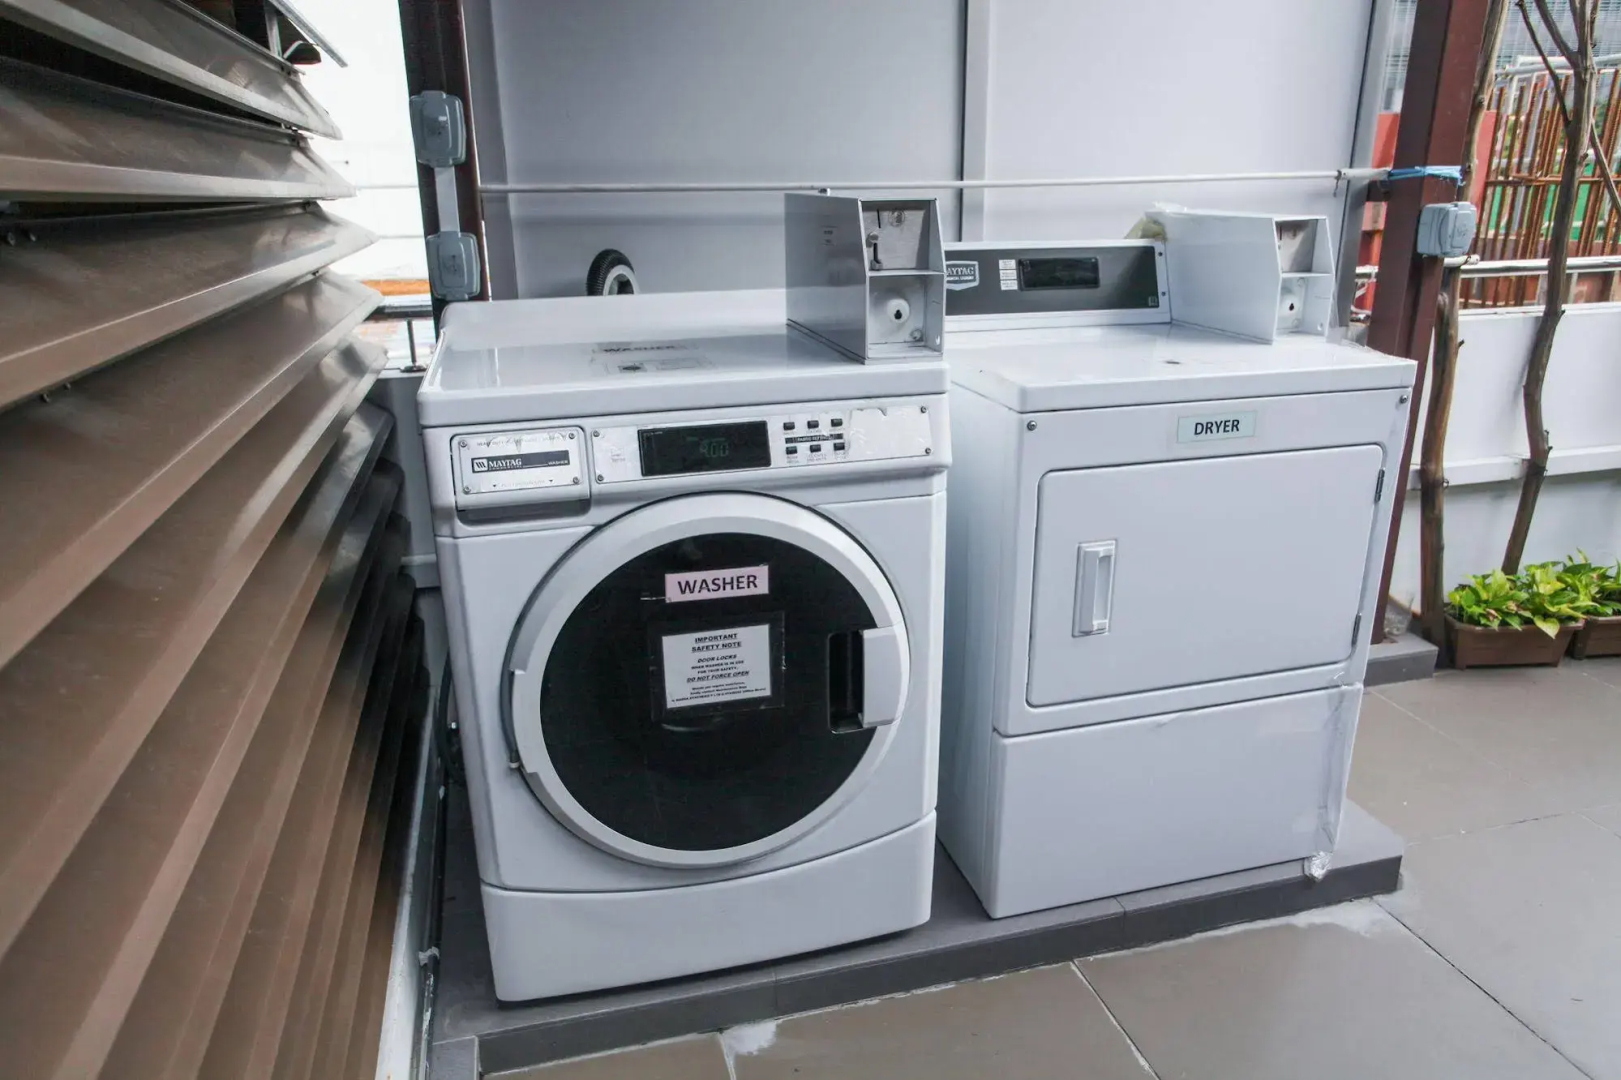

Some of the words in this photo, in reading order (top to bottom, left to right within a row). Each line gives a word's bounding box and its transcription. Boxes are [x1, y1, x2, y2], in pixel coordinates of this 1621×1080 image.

[946, 266, 974, 275] AYTAG
[1194, 419, 1240, 436] DRYER
[488, 458, 522, 468] MAYTAG
[677, 574, 758, 595] WASHER
[695, 633, 738, 643] IMPORTANT
[691, 643, 720, 653] SAFETY
[722, 641, 742, 649] NOTE
